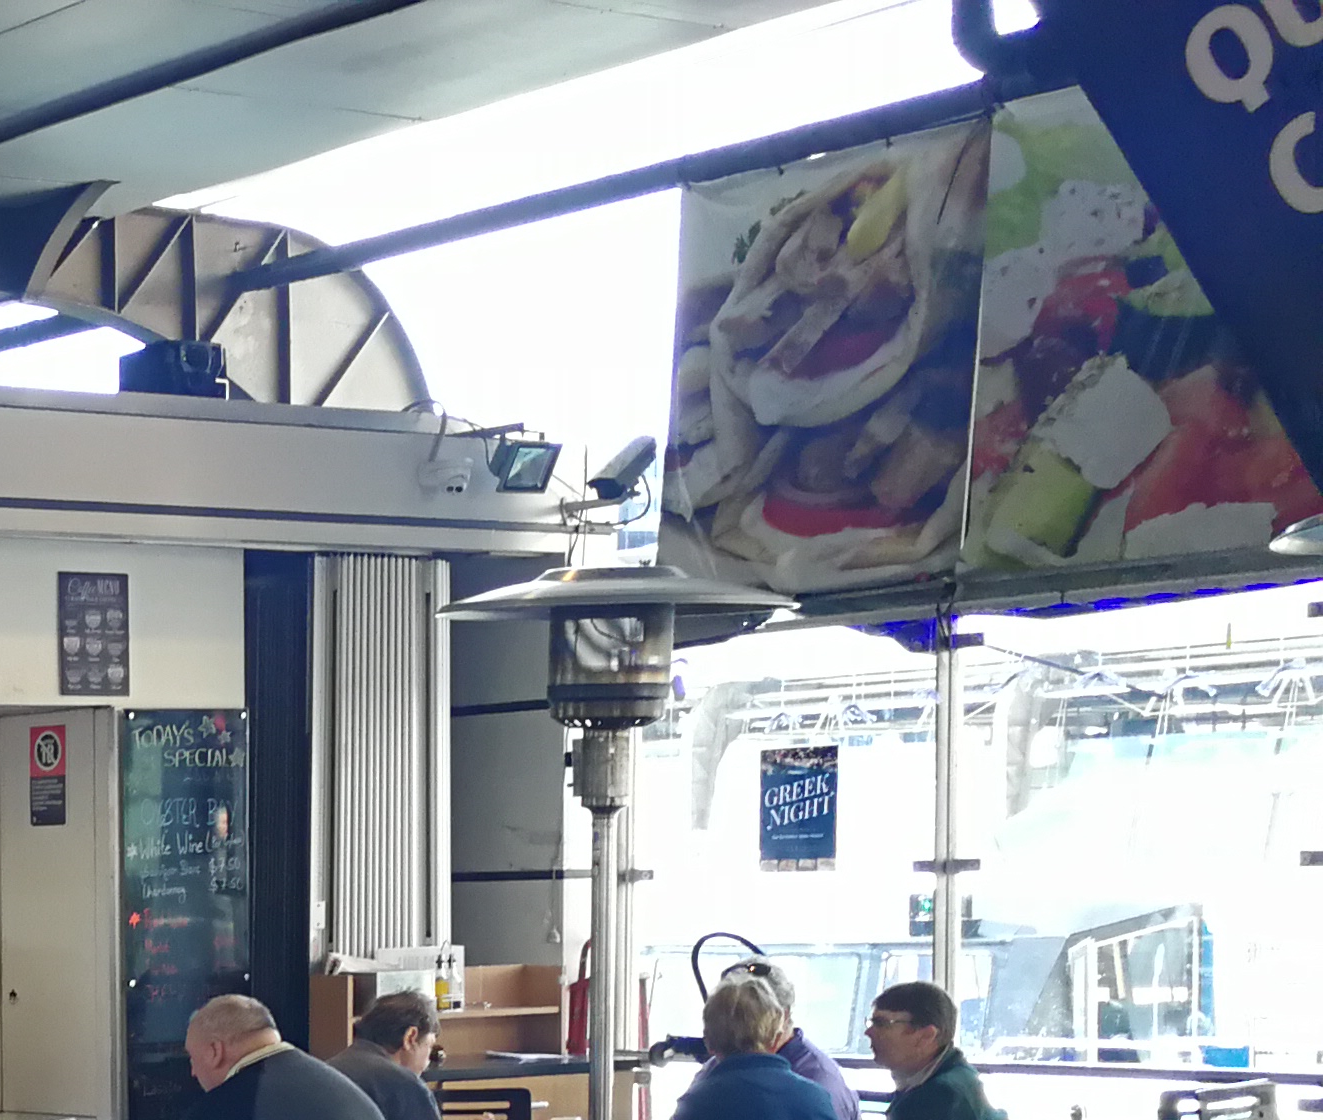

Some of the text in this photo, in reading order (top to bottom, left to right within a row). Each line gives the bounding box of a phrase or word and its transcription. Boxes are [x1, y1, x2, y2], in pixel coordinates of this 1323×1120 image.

[764, 773, 830, 808] GREEK
[766, 791, 835, 831] NIGHT
[176, 831, 204, 854] Wine
